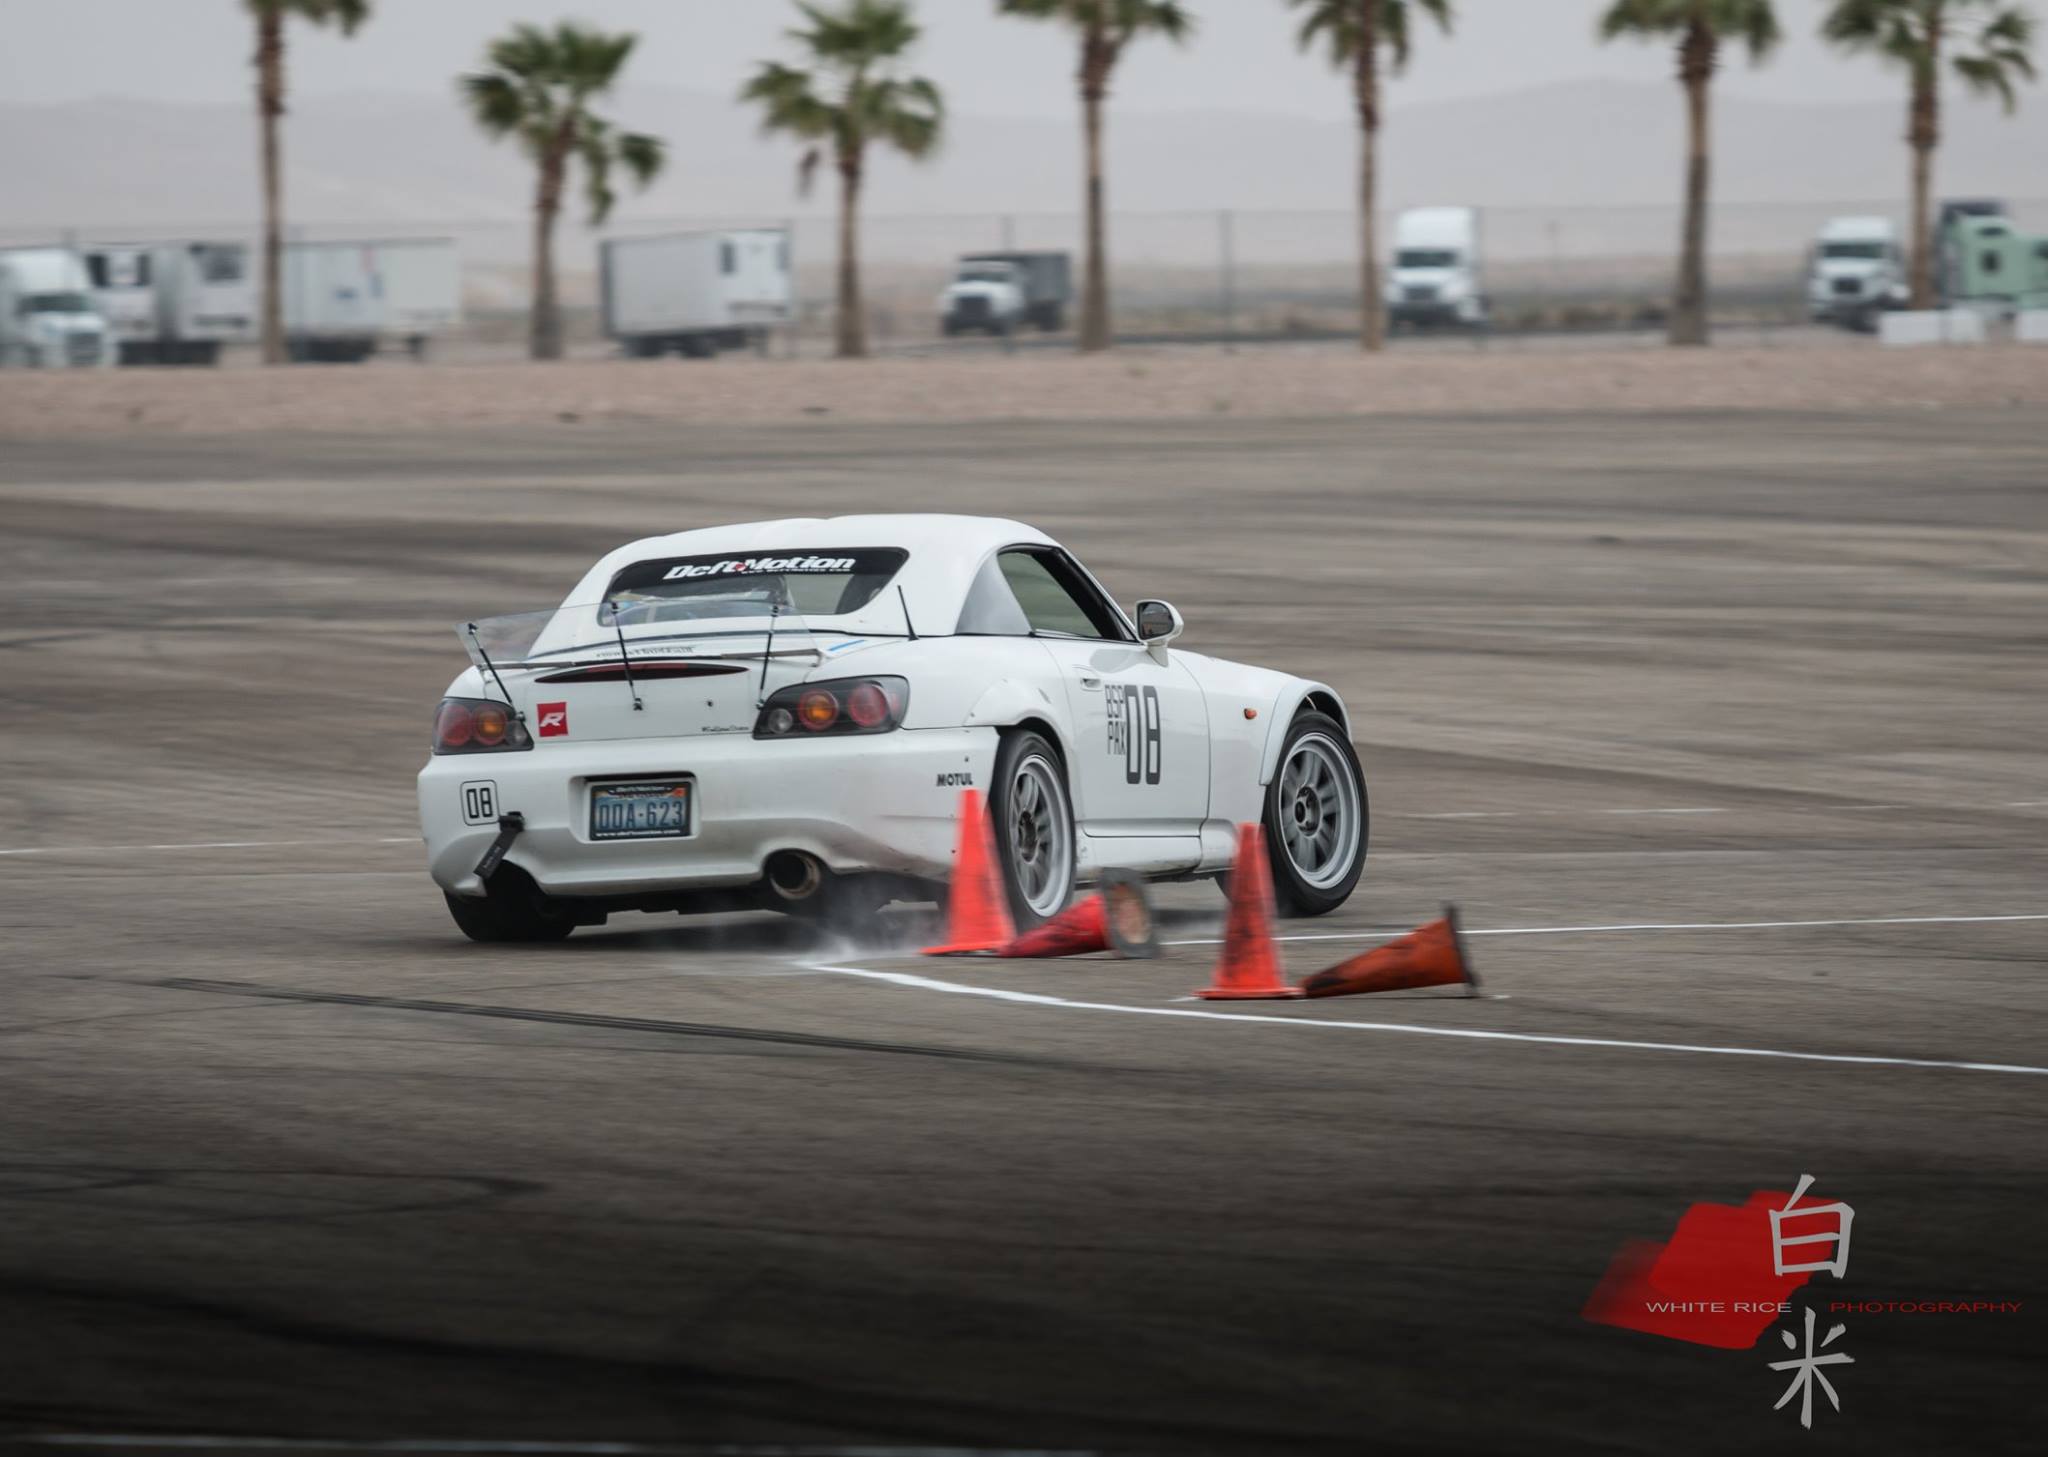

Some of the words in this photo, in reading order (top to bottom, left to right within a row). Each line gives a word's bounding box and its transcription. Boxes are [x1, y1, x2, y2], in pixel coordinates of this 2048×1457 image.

[1107, 720, 1125, 755] PAX
[1124, 684, 1161, 784] 08
[936, 773, 973, 787] MOTUL
[466, 787, 493, 819] 08
